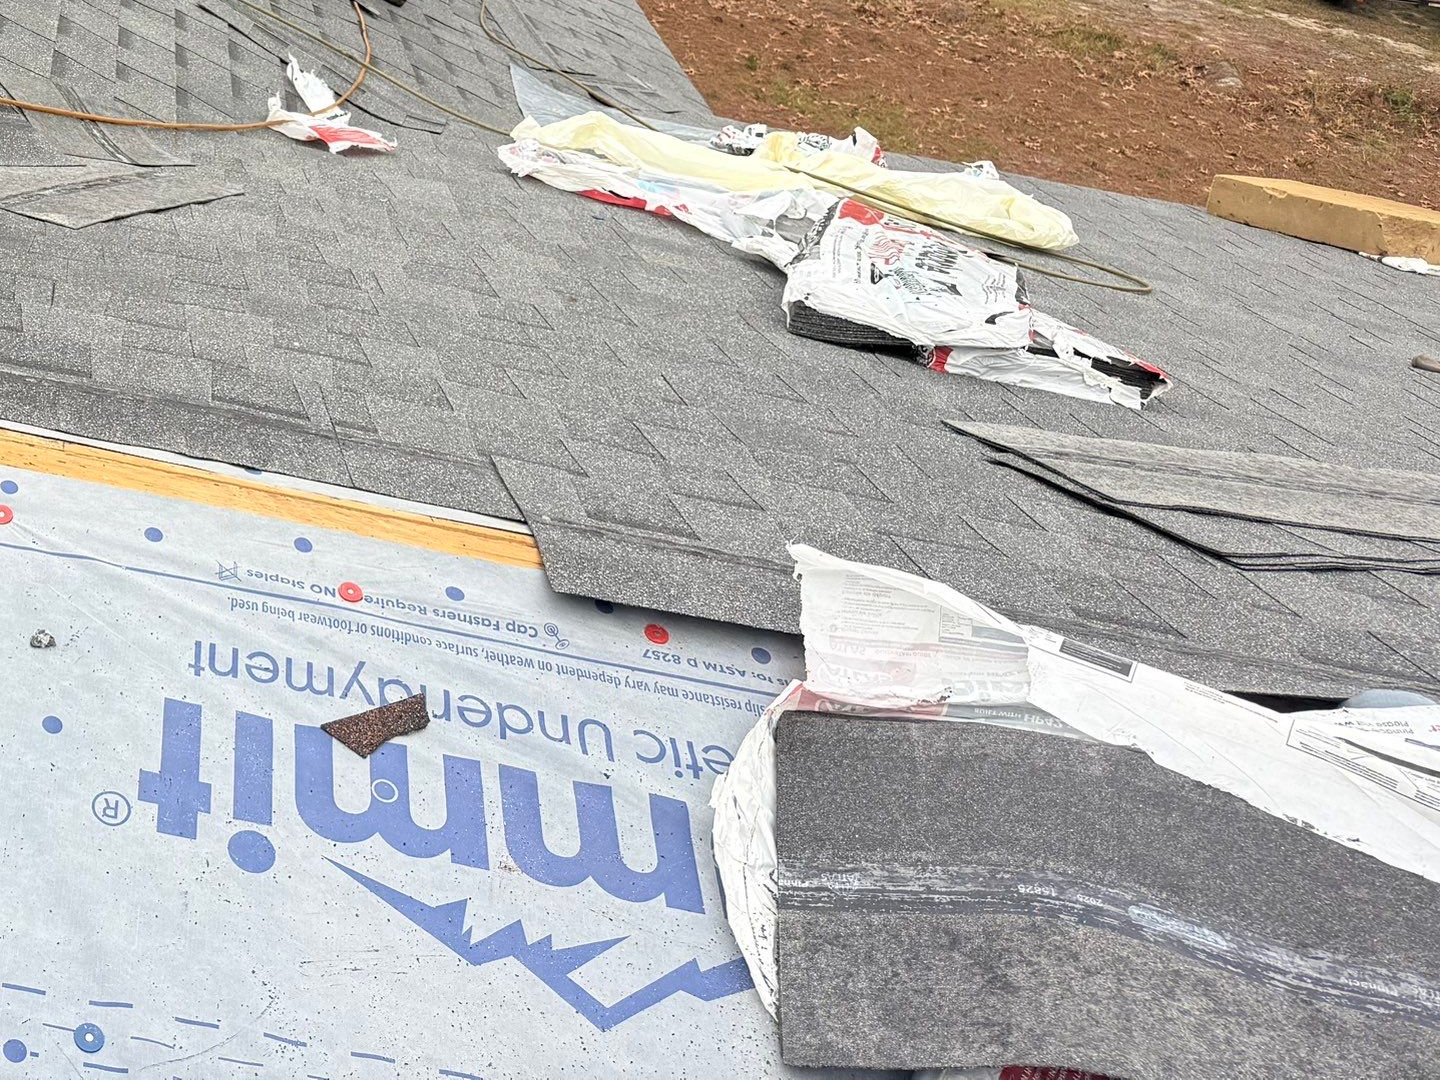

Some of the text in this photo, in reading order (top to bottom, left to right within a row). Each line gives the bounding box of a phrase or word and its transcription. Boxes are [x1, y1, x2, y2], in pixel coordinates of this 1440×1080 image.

[310, 582, 337, 598] NO
[363, 593, 427, 617] Require
[433, 606, 500, 632] Fastners
[505, 619, 538, 638] Cap
[228, 596, 766, 717] slip resistance may vary dependent on weather, surface conditions or footwear being used.
[642, 648, 683, 665] 8257
[688, 657, 698, 668] D
[703, 660, 747, 678] ASTM
[188, 638, 735, 780] etic Underayment
[137, 696, 706, 915] mmit
